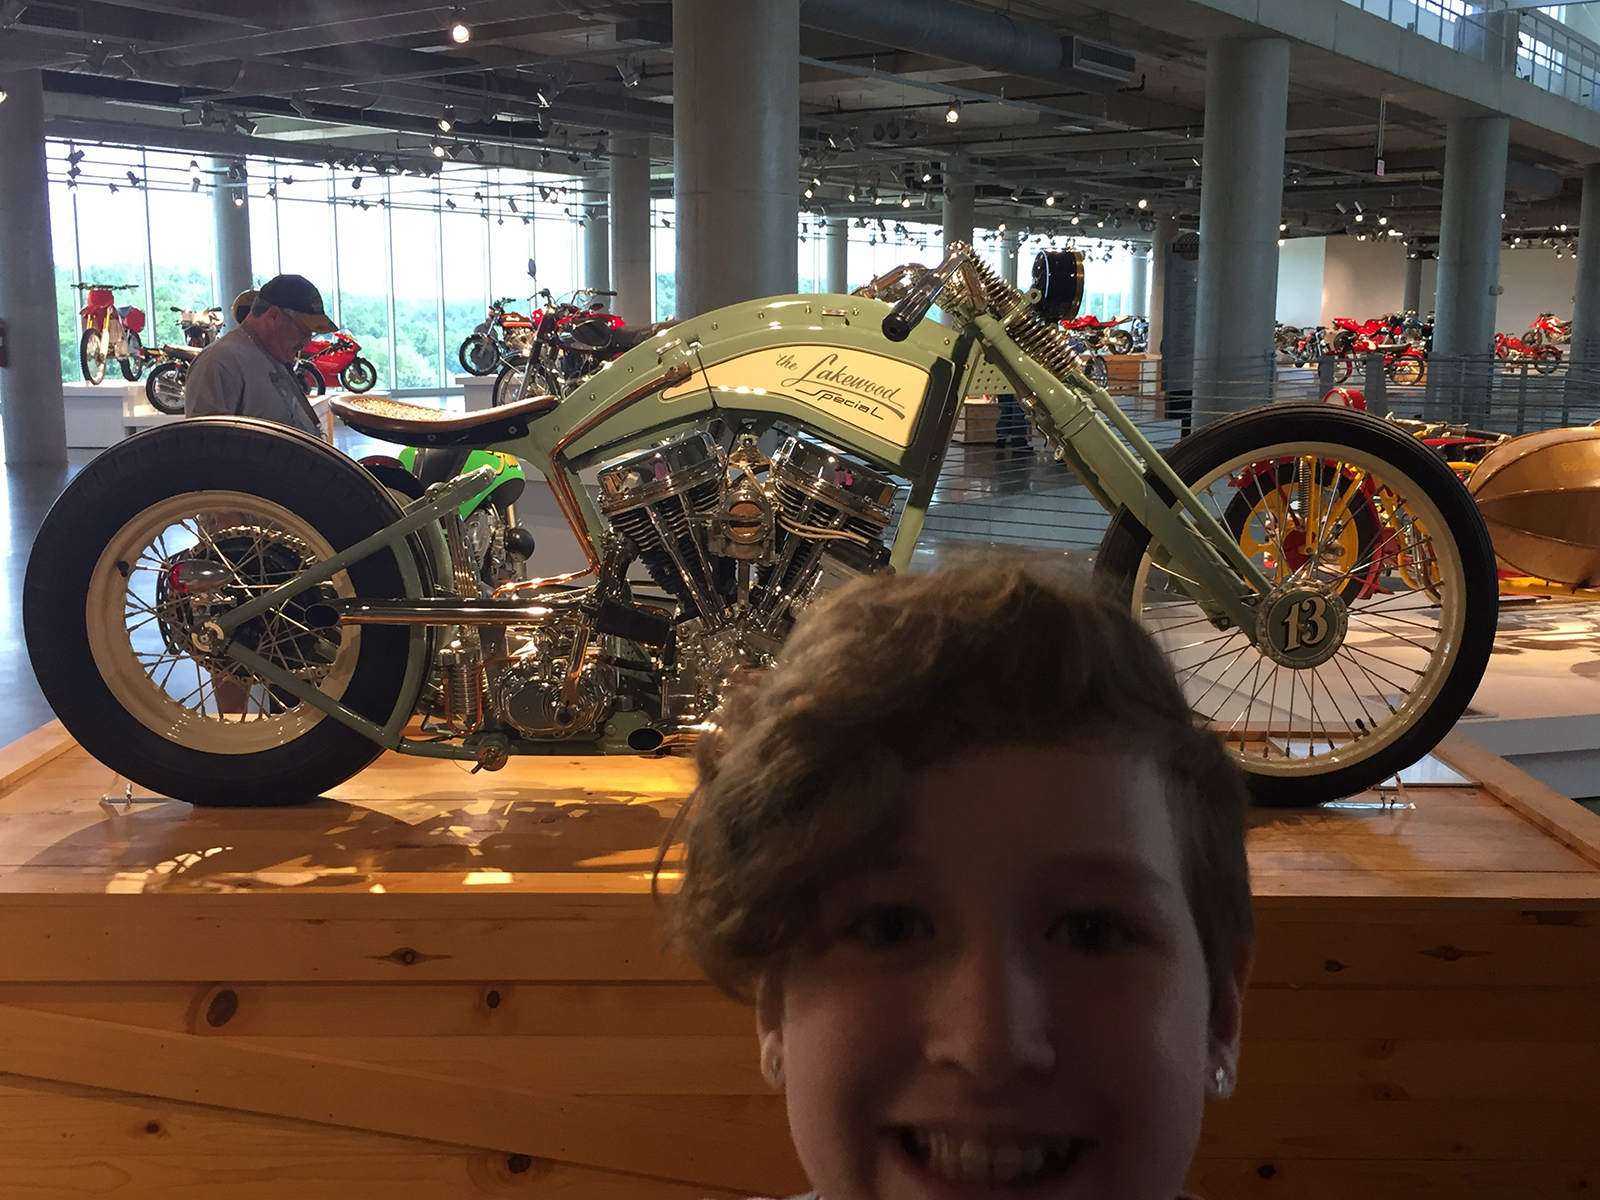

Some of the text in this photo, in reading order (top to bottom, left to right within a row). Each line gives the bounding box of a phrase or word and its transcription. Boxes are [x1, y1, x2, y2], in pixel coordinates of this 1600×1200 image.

[775, 353, 905, 415] the Lakewood
[1281, 596, 1329, 653] 13
